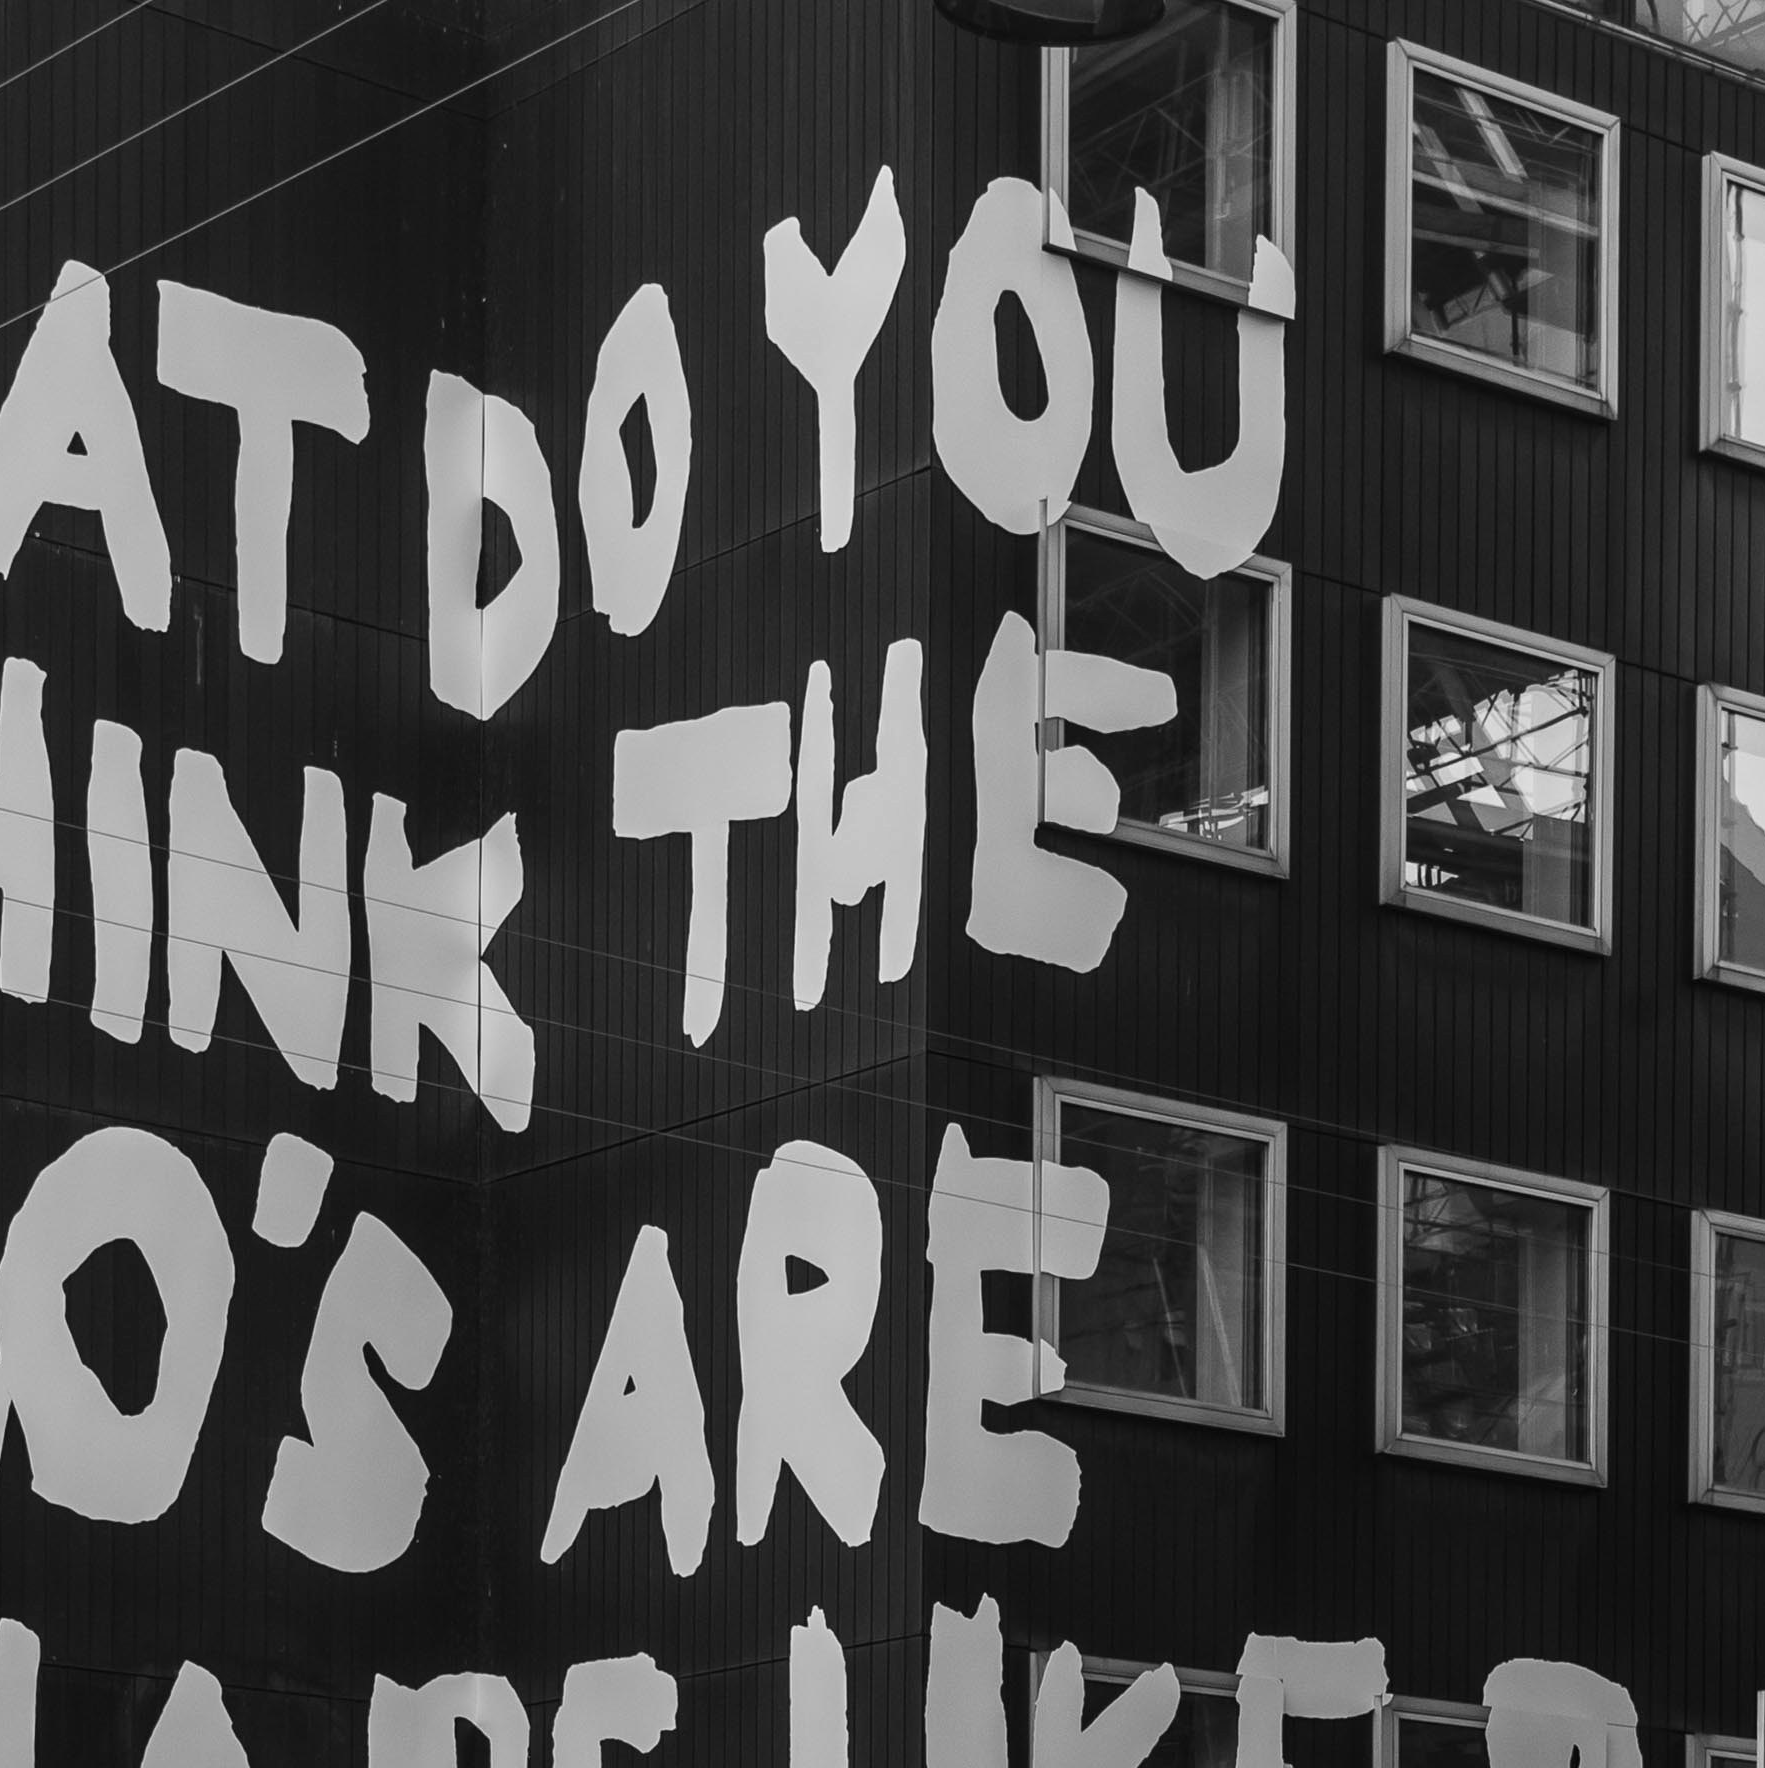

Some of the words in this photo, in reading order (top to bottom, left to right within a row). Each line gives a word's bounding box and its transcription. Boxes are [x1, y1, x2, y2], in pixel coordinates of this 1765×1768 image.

[426, 283, 692, 721] DO
[763, 165, 1297, 580] YOU
[613, 611, 1177, 1050] THE
[539, 1122, 1112, 1582] ARE
